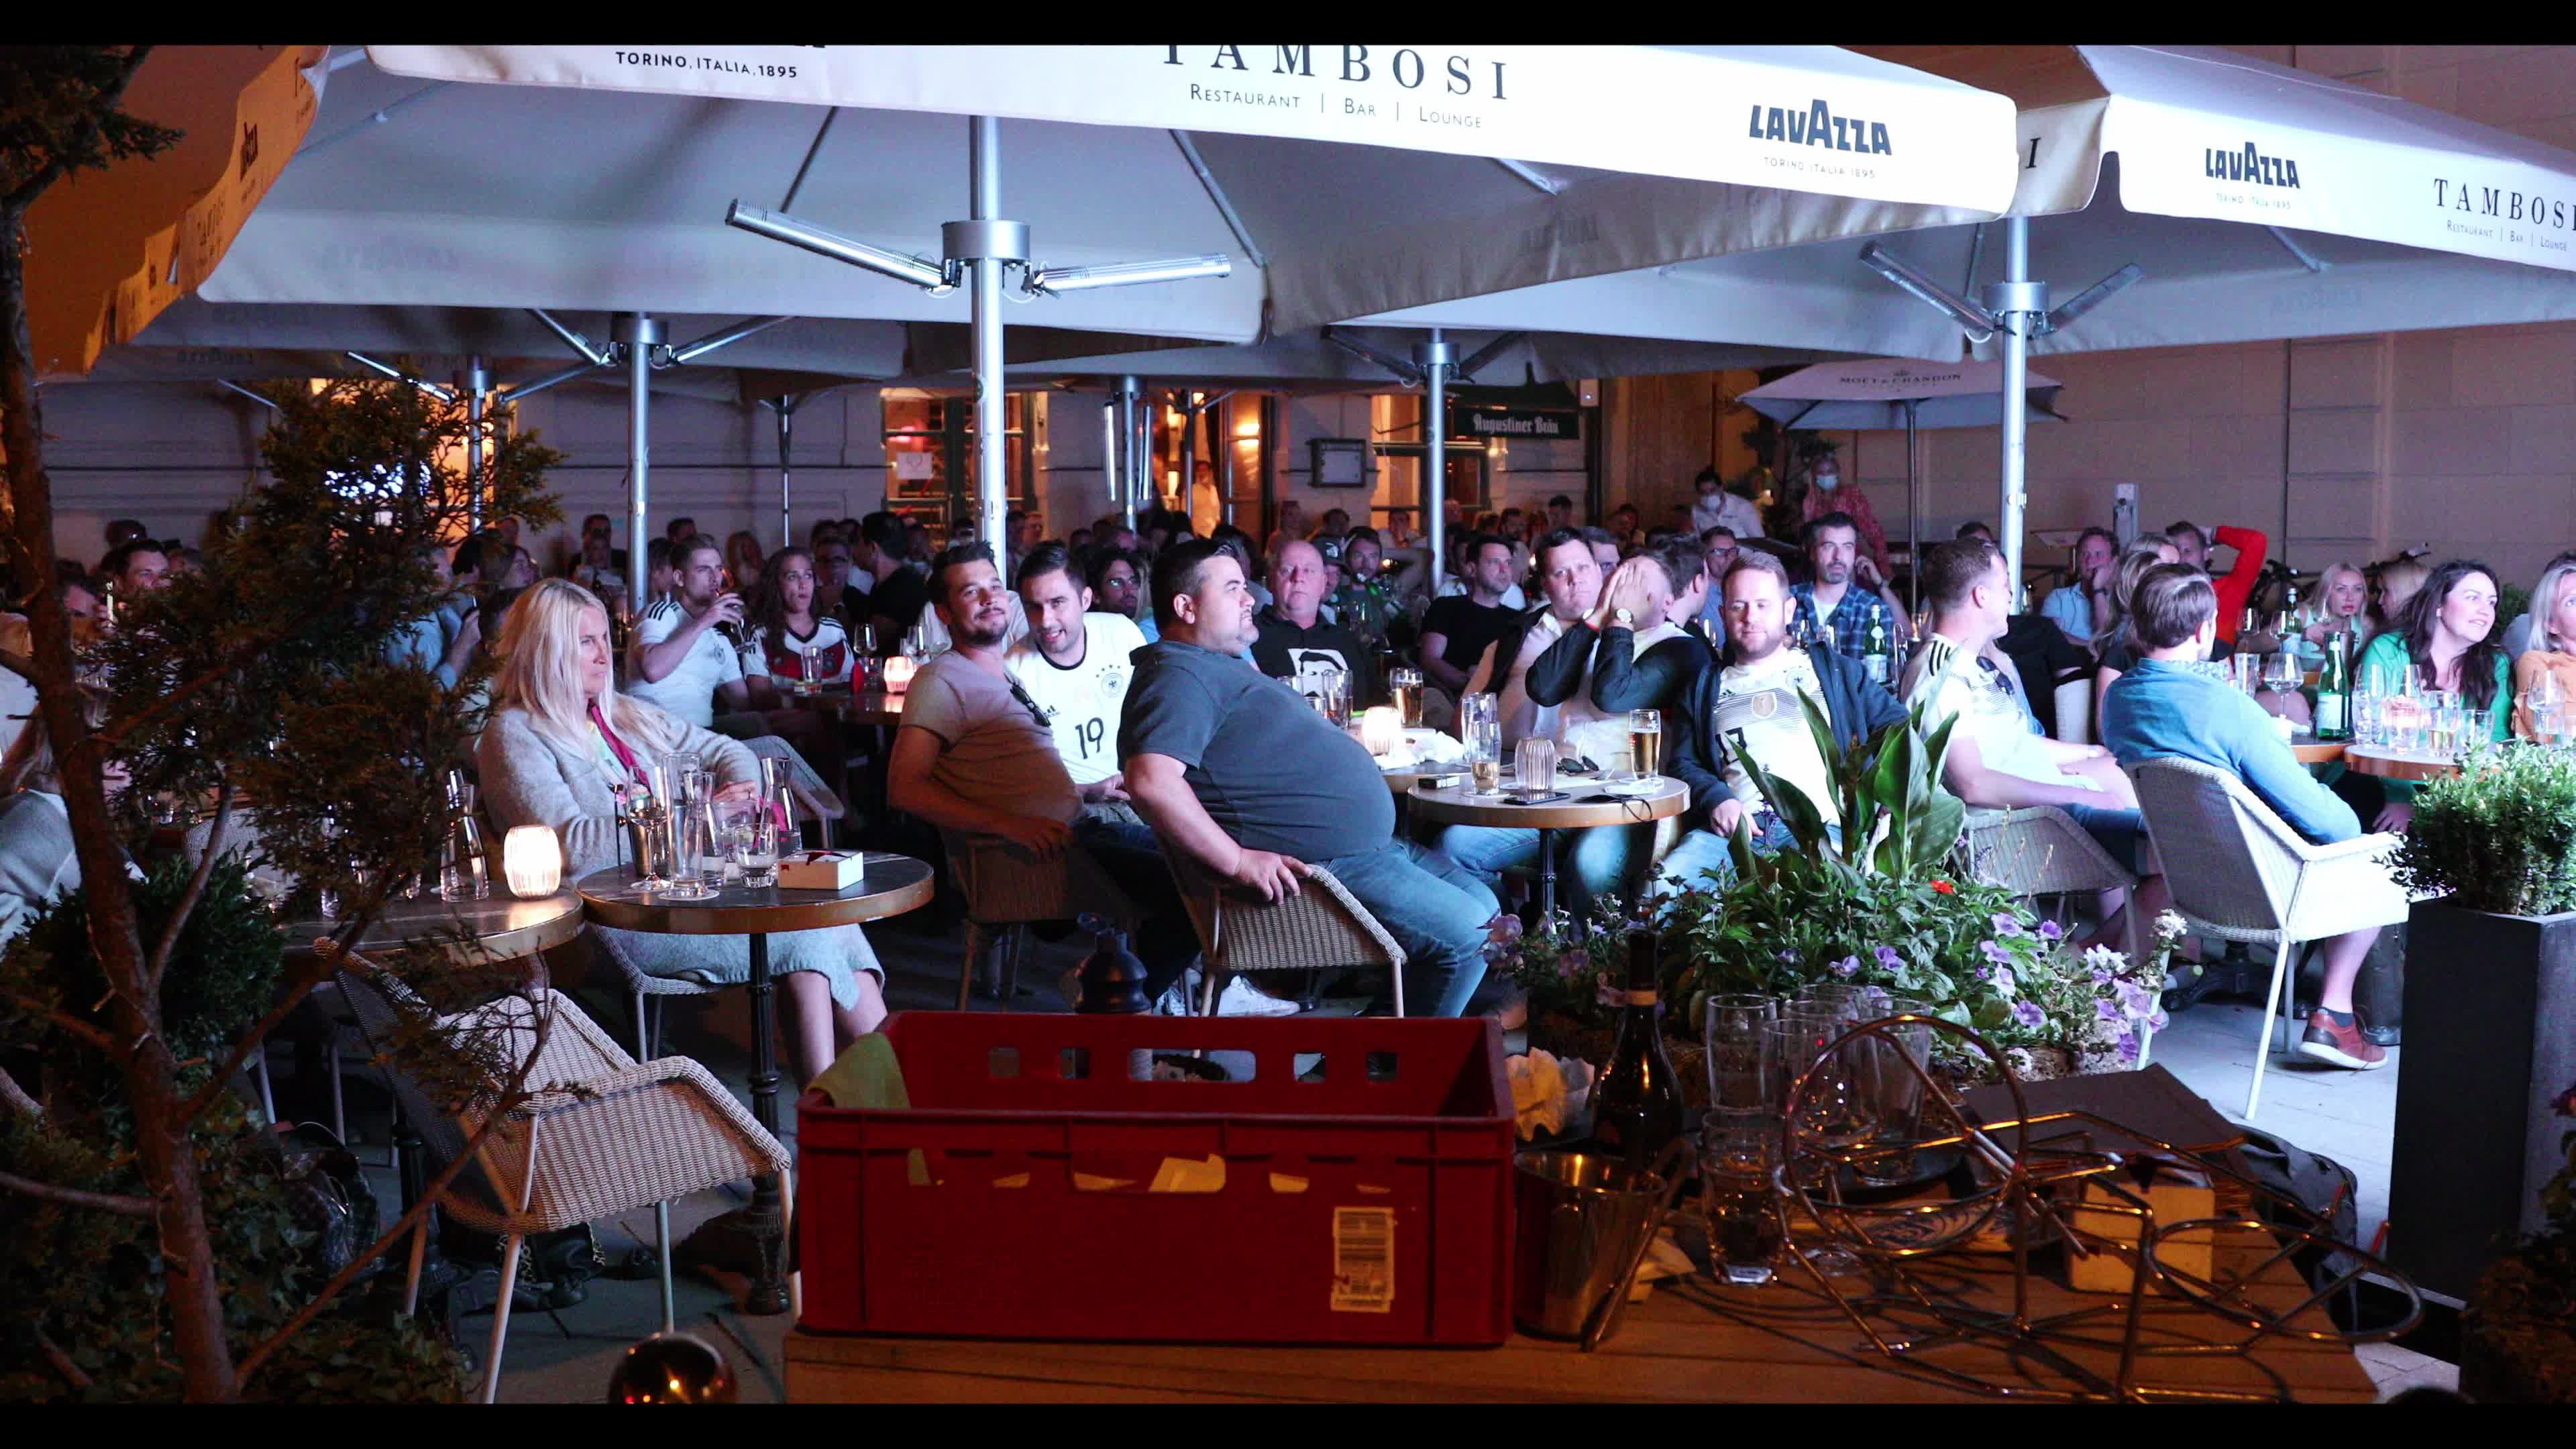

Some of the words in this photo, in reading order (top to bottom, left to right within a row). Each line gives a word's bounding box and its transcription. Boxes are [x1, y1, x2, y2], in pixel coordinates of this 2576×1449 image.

[759, 64, 797, 78] 1895
[1749, 99, 1892, 156] LAVAZZA
[2206, 141, 2301, 190] LAVAZZA
[1472, 413, 1533, 434] Augustiner
[1075, 716, 1104, 759] 19
